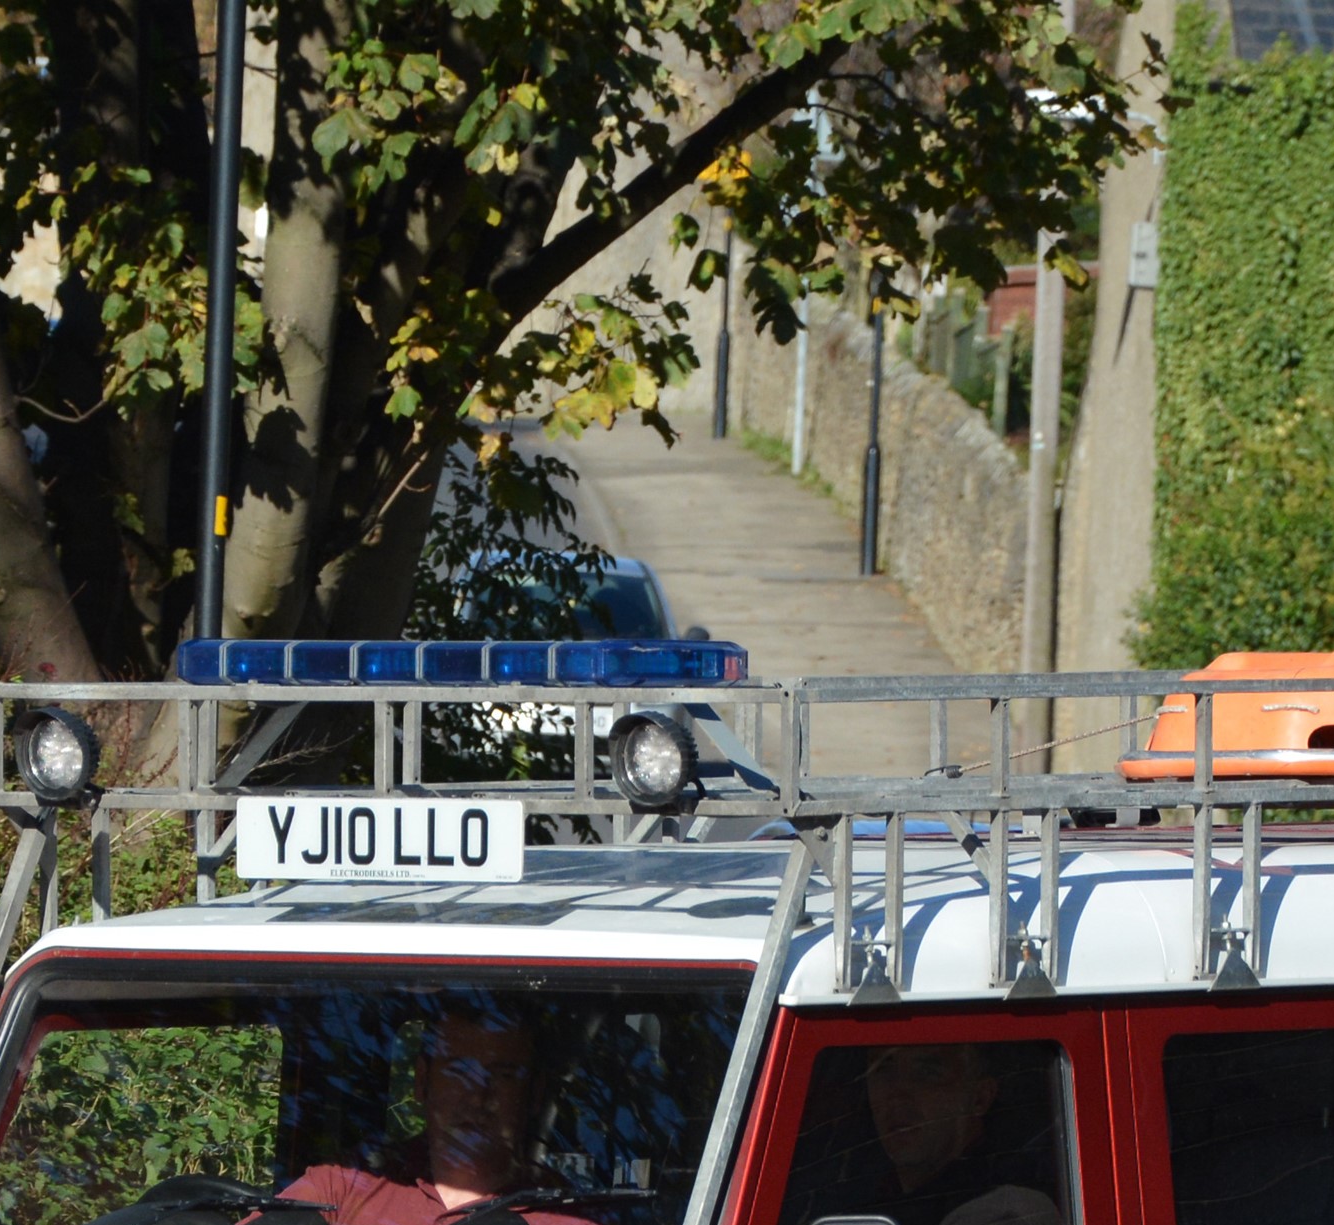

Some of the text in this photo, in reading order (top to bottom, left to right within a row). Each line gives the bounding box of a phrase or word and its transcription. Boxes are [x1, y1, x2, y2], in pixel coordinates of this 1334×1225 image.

[267, 805, 489, 867] YJ10 LLO
[330, 868, 394, 878] ELECTRODIESELS
